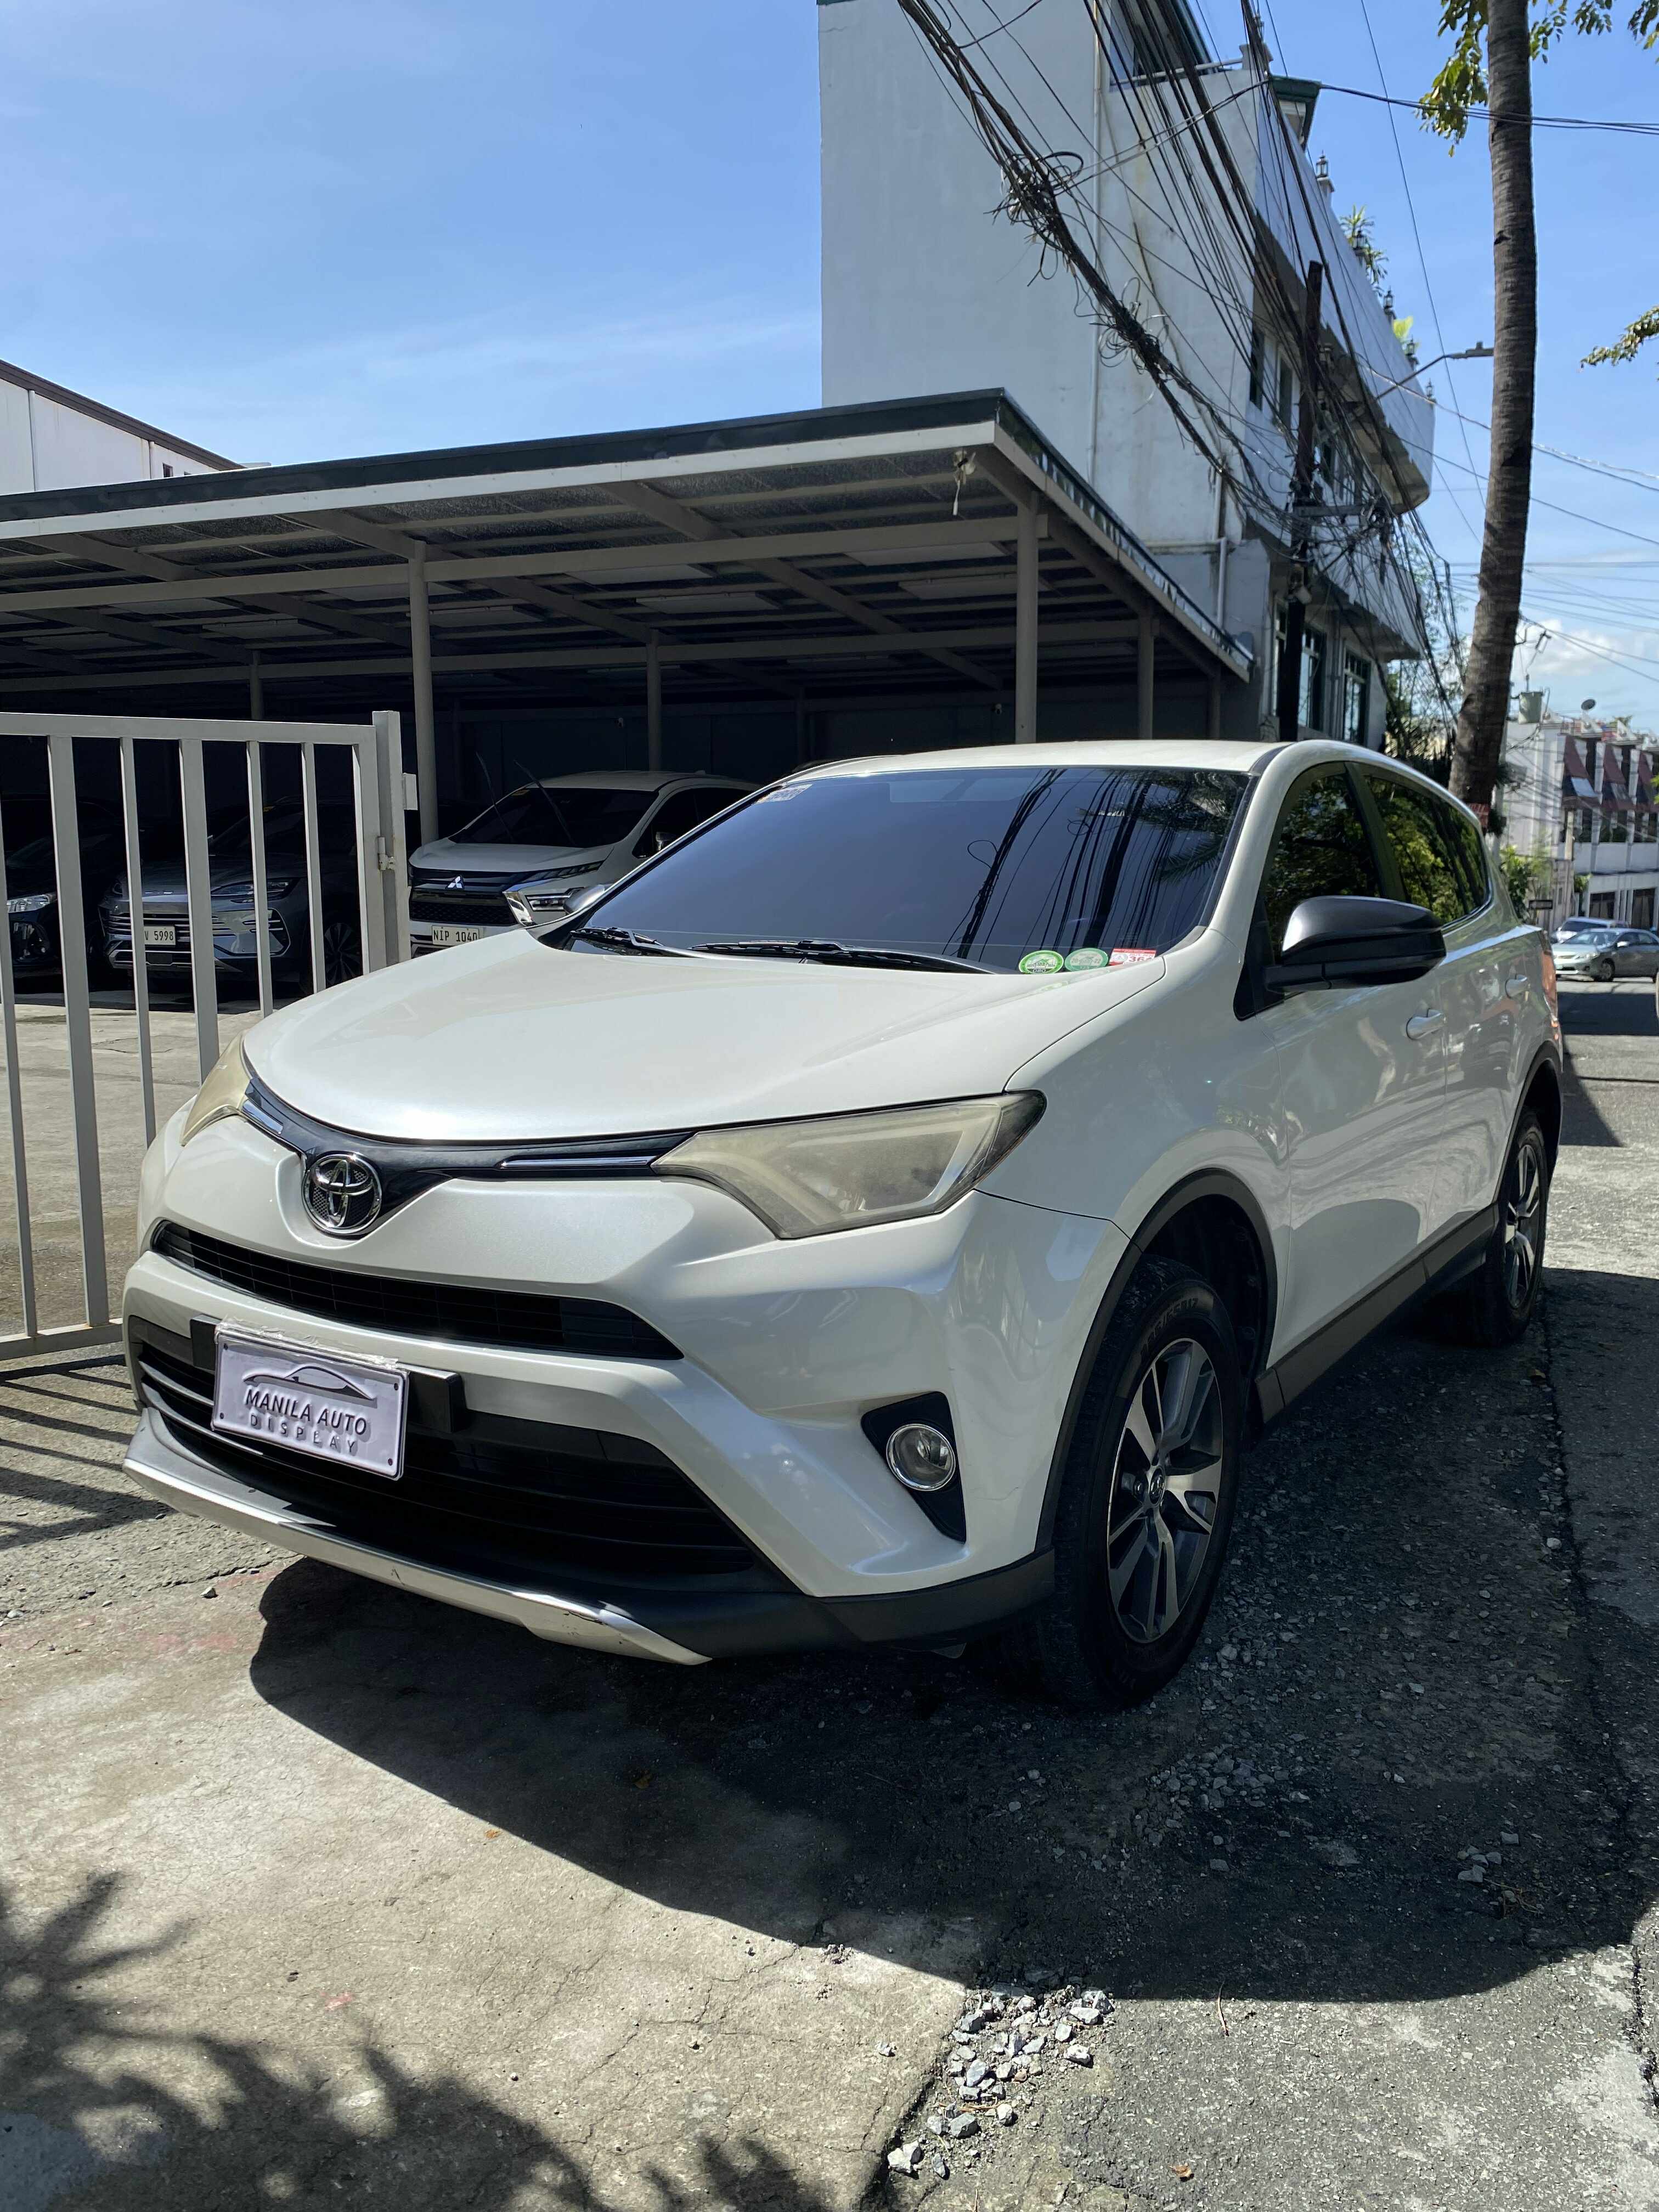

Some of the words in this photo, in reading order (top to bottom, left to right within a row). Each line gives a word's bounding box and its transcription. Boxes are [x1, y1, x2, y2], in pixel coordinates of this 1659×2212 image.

[154, 930, 174, 940] 5998
[433, 929, 450, 941] NIP
[455, 932, 477, 942] 1040
[245, 1388, 311, 1422] MANILA
[317, 1408, 367, 1436] AUTO
[250, 1413, 357, 1453] DISPLAY
